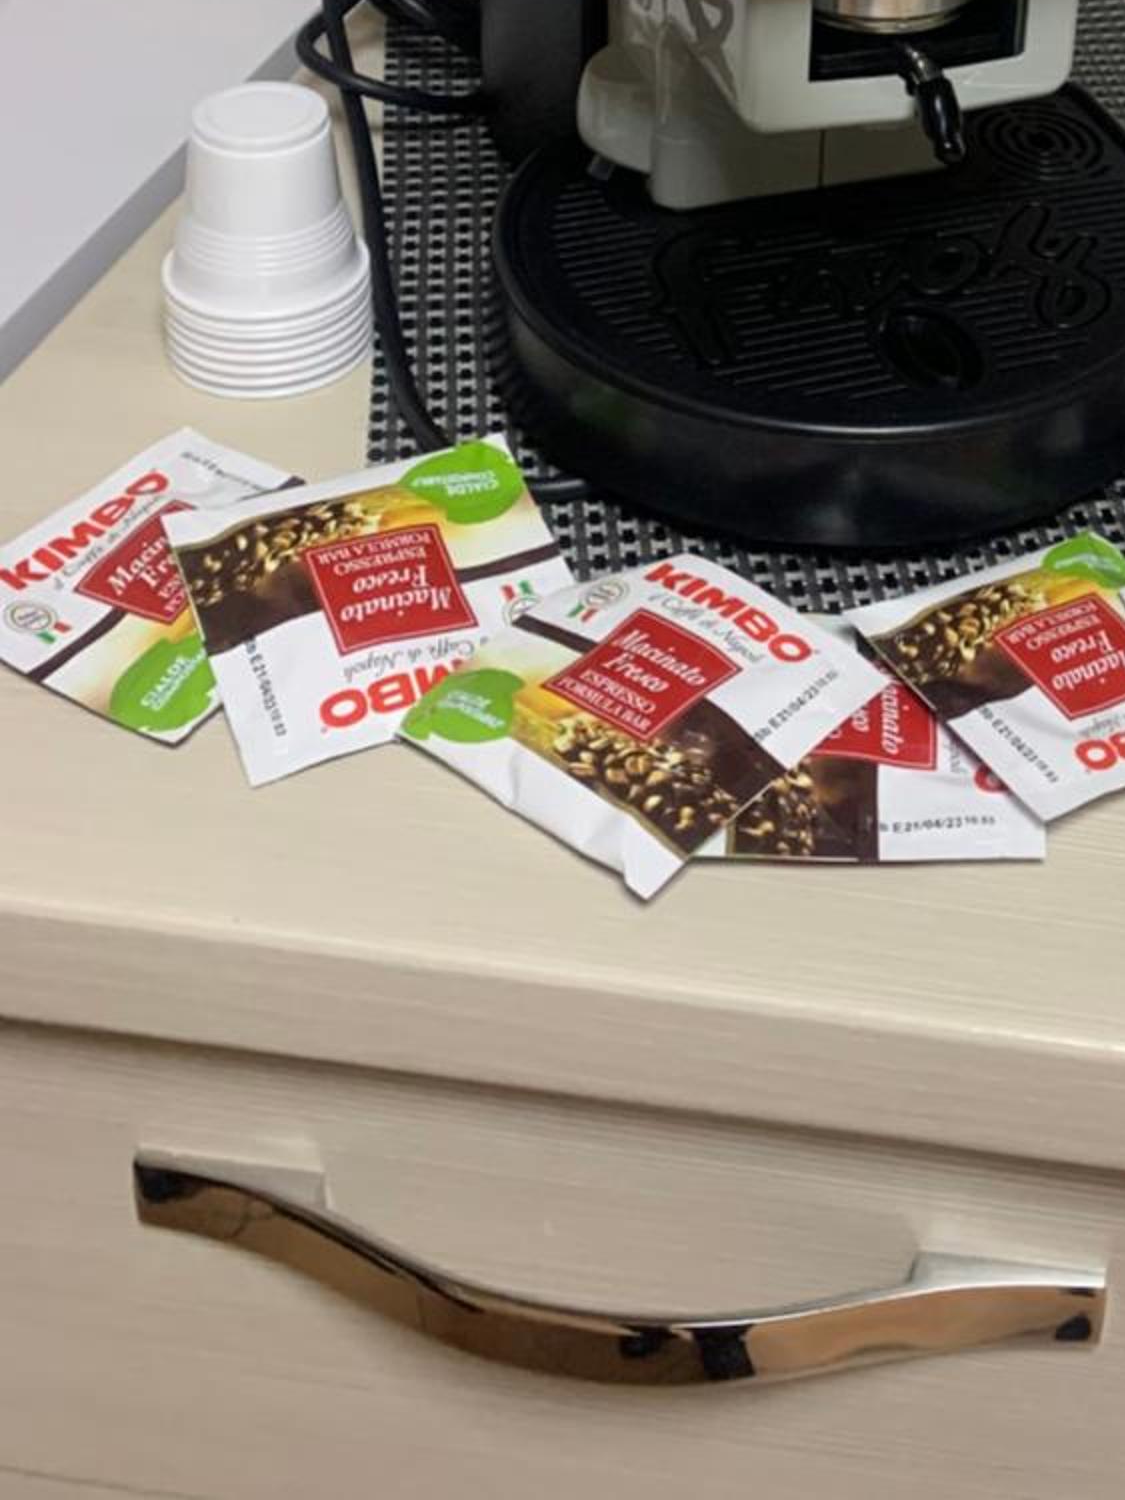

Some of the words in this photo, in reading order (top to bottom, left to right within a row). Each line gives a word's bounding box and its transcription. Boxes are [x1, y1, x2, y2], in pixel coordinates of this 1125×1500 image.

[0, 469, 170, 590] KIMBO
[105, 535, 168, 596] Macin
[317, 548, 343, 566] BAR
[334, 546, 427, 577] ESPRESSO
[352, 564, 430, 594] Fresco
[340, 586, 452, 622] Macinato
[643, 562, 813, 664] KIMBO
[611, 628, 707, 687] Macinato
[1050, 630, 1115, 663] Fresco
[580, 669, 657, 714] ESPRESSO
[602, 651, 672, 692] Fresco
[319, 658, 463, 728] MBO
[619, 707, 652, 732] BAR
